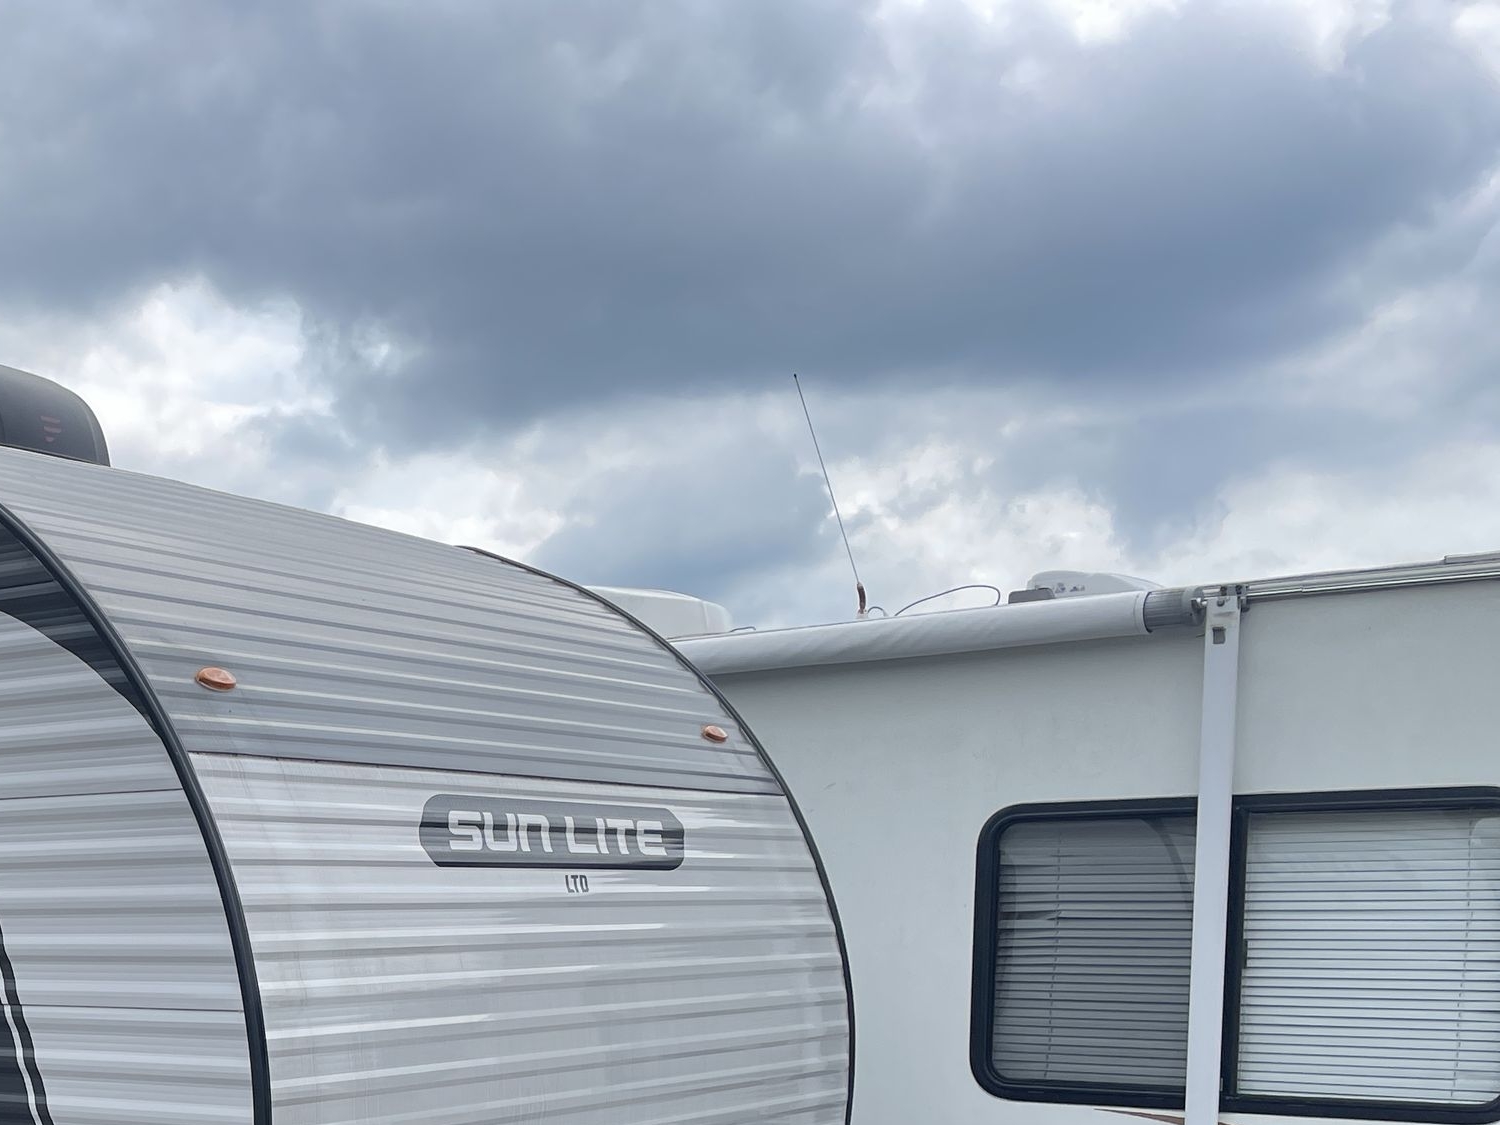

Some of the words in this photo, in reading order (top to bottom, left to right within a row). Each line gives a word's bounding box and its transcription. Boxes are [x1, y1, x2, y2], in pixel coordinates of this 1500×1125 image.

[447, 810, 554, 853] SUN
[564, 815, 669, 856] LITE
[564, 874, 590, 893] LTD
